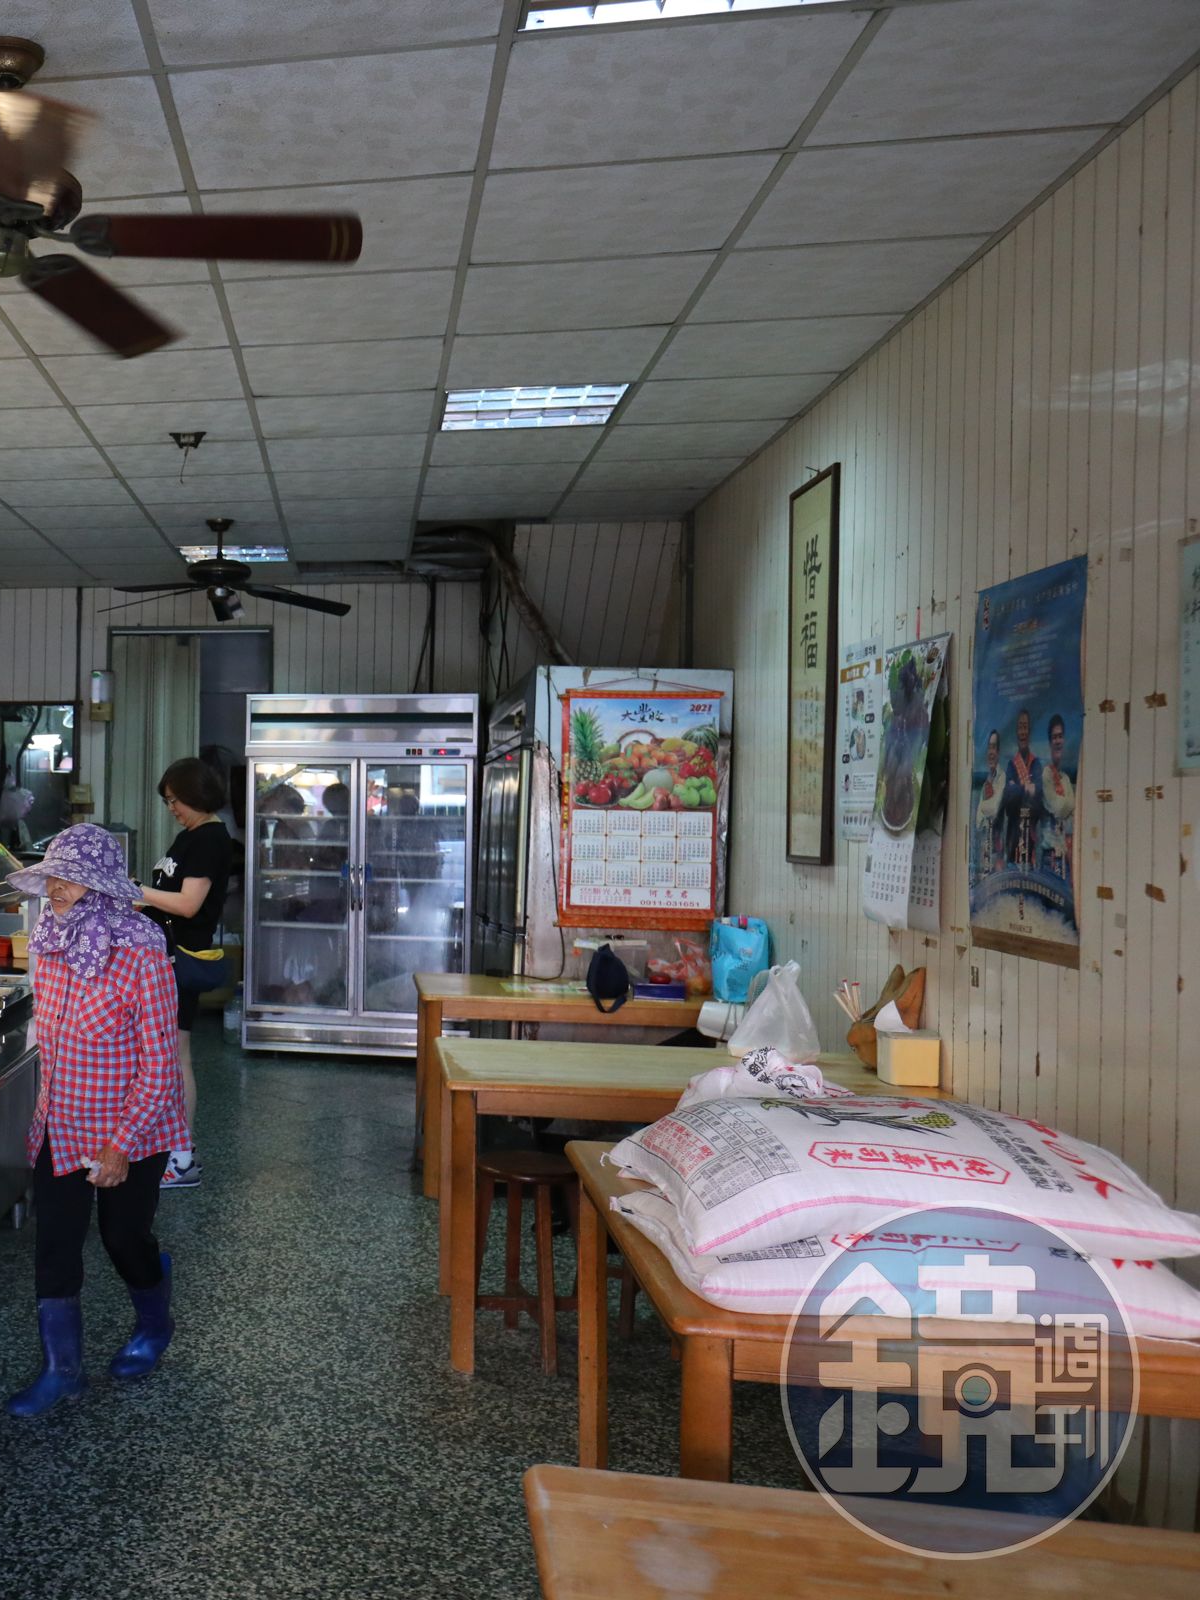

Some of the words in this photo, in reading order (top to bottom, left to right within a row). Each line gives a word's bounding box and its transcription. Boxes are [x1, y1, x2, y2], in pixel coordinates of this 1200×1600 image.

[800, 533, 822, 675] 惜福
[689, 703, 713, 713] 2021
[823, 1146, 996, 1178] 純正壽司米
